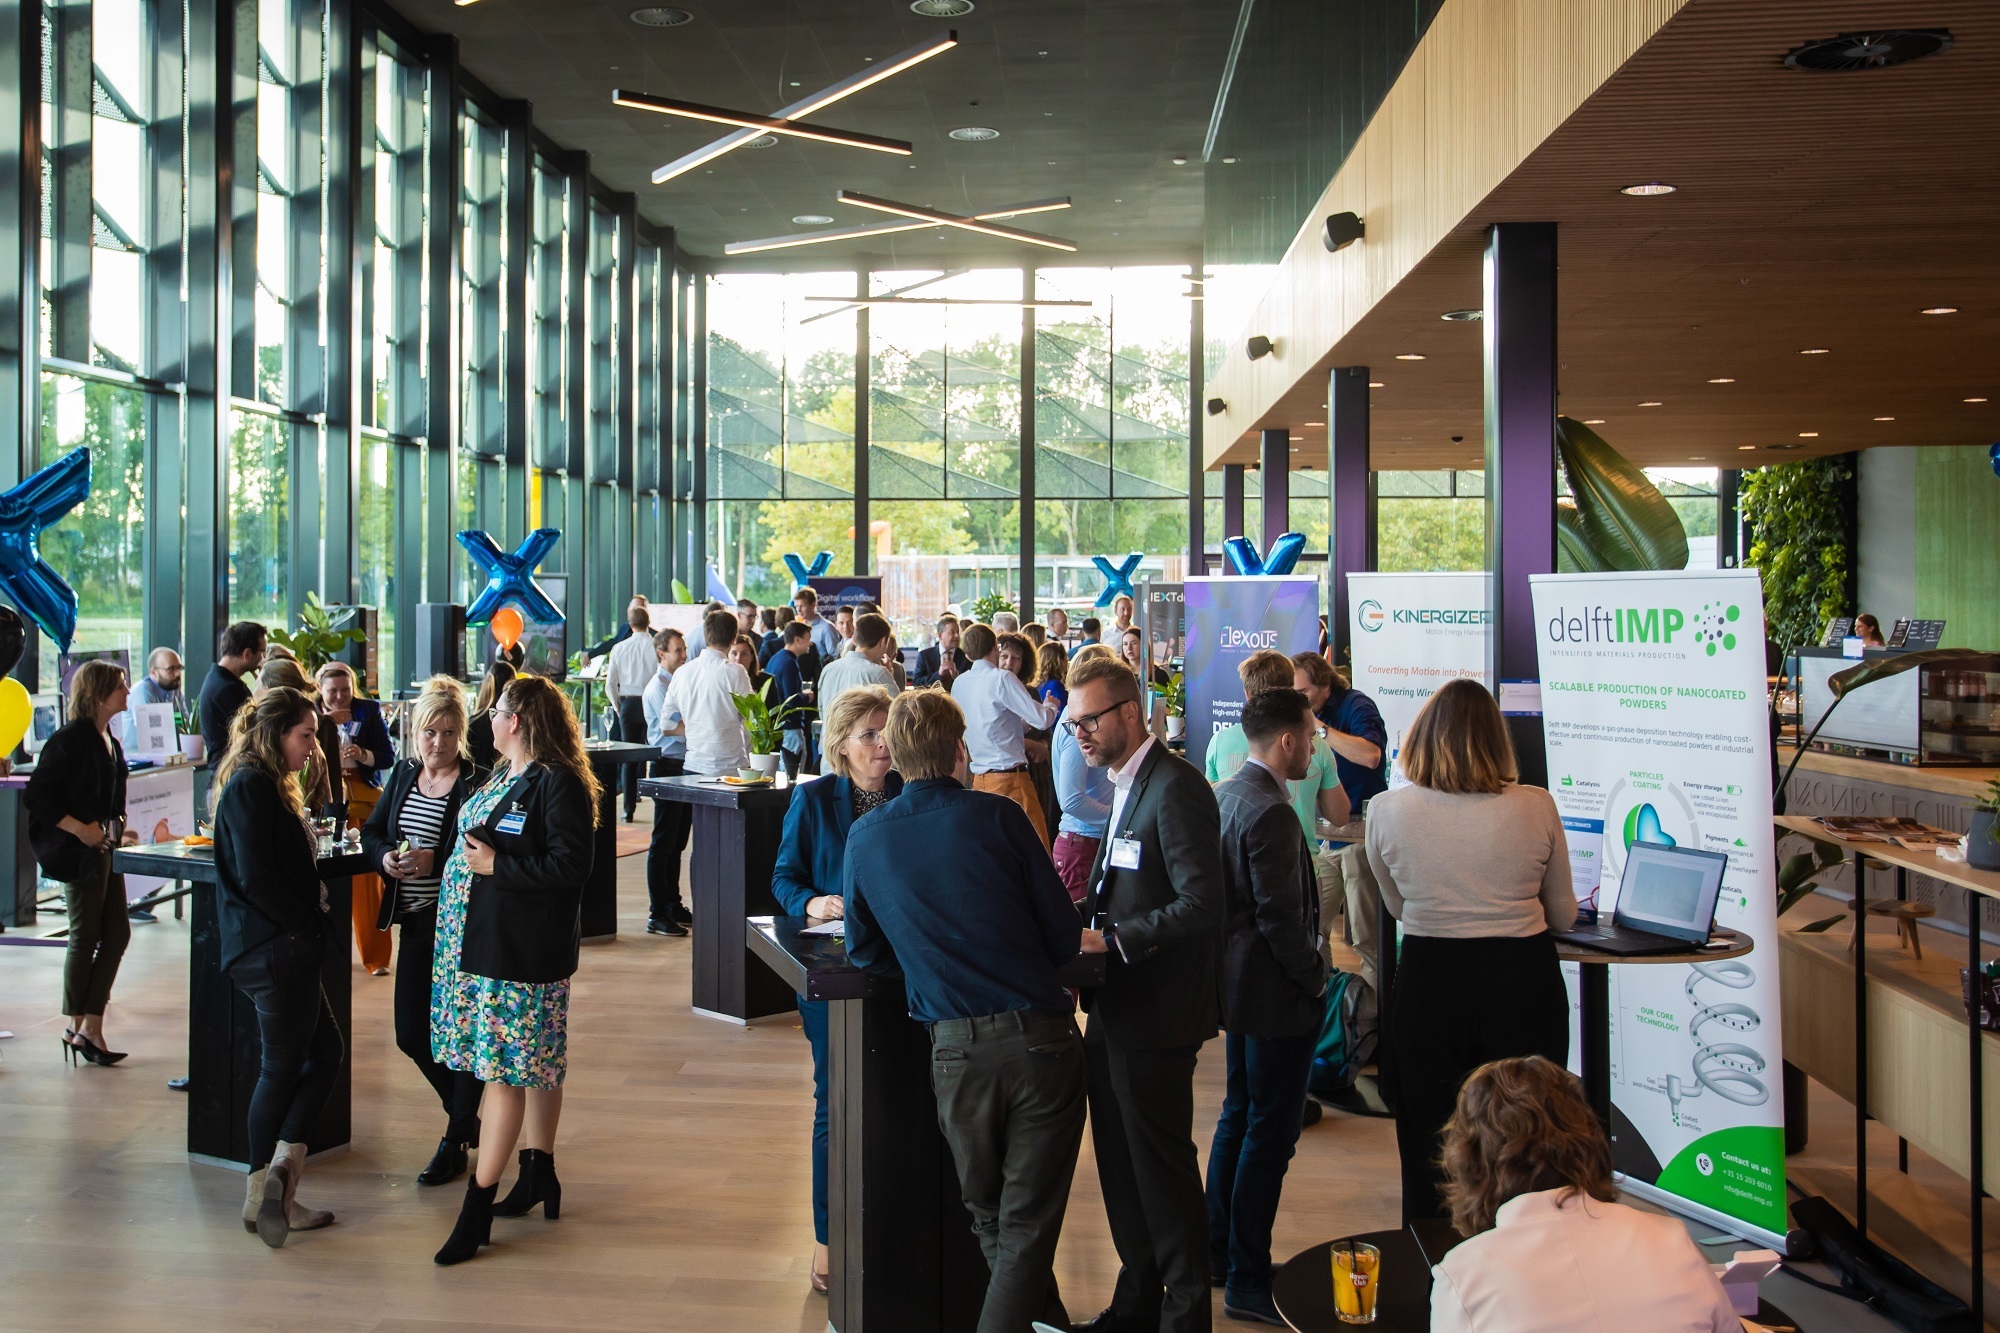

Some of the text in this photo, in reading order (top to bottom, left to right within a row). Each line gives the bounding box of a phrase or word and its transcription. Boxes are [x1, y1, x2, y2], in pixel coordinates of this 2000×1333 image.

[841, 593, 876, 602] workflow
[1549, 606, 1684, 644] delftIMP
[1220, 626, 1278, 649] Flexous
[1445, 629, 1463, 637] Energy
[1596, 651, 1635, 659] MATERIALS
[1638, 652, 1686, 660] PRODUCTION
[1368, 664, 1409, 676] Converting
[1411, 666, 1440, 676] Motion
[1442, 667, 1458, 677] into
[1378, 686, 1414, 698] Powering
[1549, 681, 1746, 700] SCALABLE PRODUCTION OF NANOCOATED
[1619, 698, 1667, 710] POWDERS
[1212, 709, 1236, 717] High-end
[1572, 723, 1600, 731] develops
[1606, 725, 1635, 733] gas-phase
[1636, 727, 1667, 736] deposition
[1668, 729, 1704, 740] technology
[1705, 732, 1732, 743] enabling
[1733, 735, 1752, 743] cost-
[1548, 730, 1570, 738] effective
[1583, 732, 1613, 741] continuous
[1614, 734, 1645, 744] production
[1645, 737, 1652, 745] of
[1652, 737, 1688, 748] nanocoated
[1688, 741, 1713, 752] powders
[1722, 745, 1754, 754] industrial
[1549, 739, 1563, 747] scale.
[1629, 770, 1664, 781] PARTICLES
[1575, 780, 1600, 788] Catalysis
[1632, 780, 1662, 791] COATING
[1683, 781, 1722, 793] Energy storage
[1705, 811, 1738, 820] encapsulation
[1705, 833, 1729, 843] Pigments
[1732, 865, 1759, 875] overlayer
[1640, 1006, 1674, 1021] OUR CORE
[1636, 1014, 1680, 1032] TECHNOLOGY
[1646, 1076, 1656, 1084] Gas
[1632, 1081, 1666, 1095] post-treatment
[1721, 1151, 1772, 1175] Contact us at:
[1722, 1169, 1734, 1178] +31
[1735, 1172, 1744, 1181] 15
